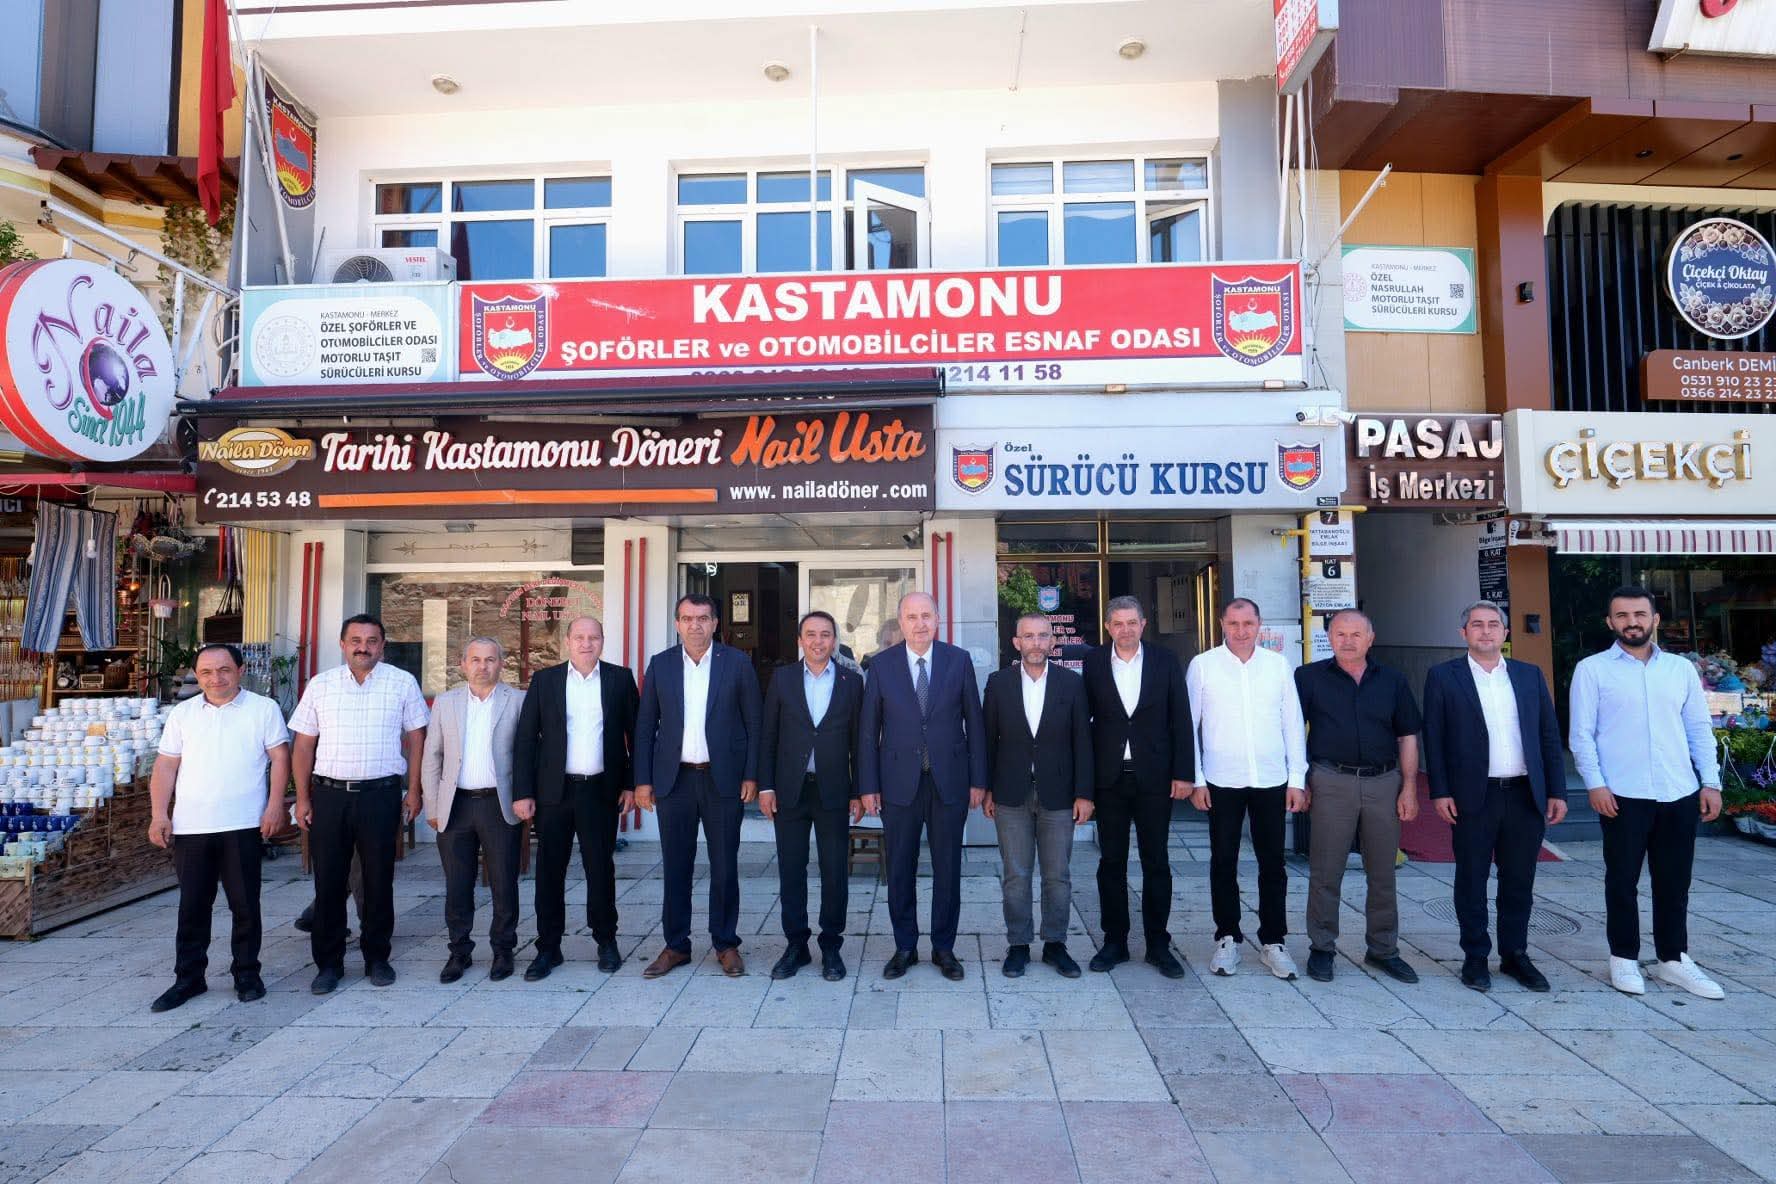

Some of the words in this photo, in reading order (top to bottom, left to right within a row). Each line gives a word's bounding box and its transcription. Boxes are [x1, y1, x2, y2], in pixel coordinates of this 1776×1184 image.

[1370, 272, 1393, 281] ÖZEL
[1683, 264, 1726, 281] Çiçekçi
[1728, 265, 1768, 284] Oktay
[1371, 284, 1424, 293] NASRULLAH
[1696, 281, 1716, 289] ÇİÇEK
[1723, 281, 1756, 289] ÇİKOLATA
[693, 275, 1062, 323] KASTAMONU
[1371, 295, 1414, 304] MOTORLU
[1416, 296, 1440, 306] TAŞIT
[320, 311, 365, 319] KASTAMONU
[370, 310, 399, 318] MERKEZ
[484, 304, 536, 312] KASTAMONU
[1371, 304, 1426, 315] SÜRÜCÜLERİ
[1428, 307, 1457, 316] KURSU
[320, 322, 346, 333] ÖZEL
[349, 320, 402, 334] ŞOFÖRLER
[404, 320, 417, 330] VE
[32, 275, 159, 411] Naila
[320, 335, 403, 348] OTOMOBİLCİLER
[405, 335, 438, 345] ODASI
[561, 336, 711, 366] ŞOFÖRLER
[719, 342, 750, 357] ve
[759, 329, 996, 356] OTOMOBİLCİLER
[1006, 330, 1100, 352] ESNAF
[1111, 327, 1200, 349] ODASI
[320, 353, 371, 363] MOTORLU
[373, 352, 401, 363] TAŞIT
[1672, 357, 1734, 370] Canberk
[320, 365, 384, 379] SÜRÜCÜLERİ
[387, 366, 422, 377] KURSU
[949, 365, 990, 382] 214
[999, 365, 1024, 381] 11
[1034, 364, 1062, 380] 58
[1681, 375, 1712, 386] 0531
[1716, 376, 1740, 386] 910
[1744, 377, 1760, 387] 23
[1681, 388, 1715, 398] 0366
[1720, 388, 1741, 398] 214
[1745, 389, 1761, 399] 23
[109, 391, 147, 447] 1944
[321, 432, 412, 472] Tarihi
[423, 430, 601, 470] Kastamonu
[609, 427, 723, 467] Döneri
[730, 415, 824, 469] Nail
[829, 411, 926, 464] Usta
[1357, 418, 1503, 459] PASAJ
[201, 441, 254, 460] Naila
[259, 440, 309, 457] Döner
[1004, 442, 1032, 452] Özel
[1544, 427, 1753, 490] ÇİÇEKÇİ
[1004, 453, 1140, 496] SÜRÜCÜ
[1150, 462, 1268, 496] KURSU
[1369, 464, 1391, 503] İş
[1399, 470, 1494, 500] Merkezi
[216, 492, 252, 508] 214
[256, 491, 281, 507] 53
[286, 490, 311, 507] 48
[1326, 511, 1334, 523] 7
[1328, 566, 1336, 577] 6
